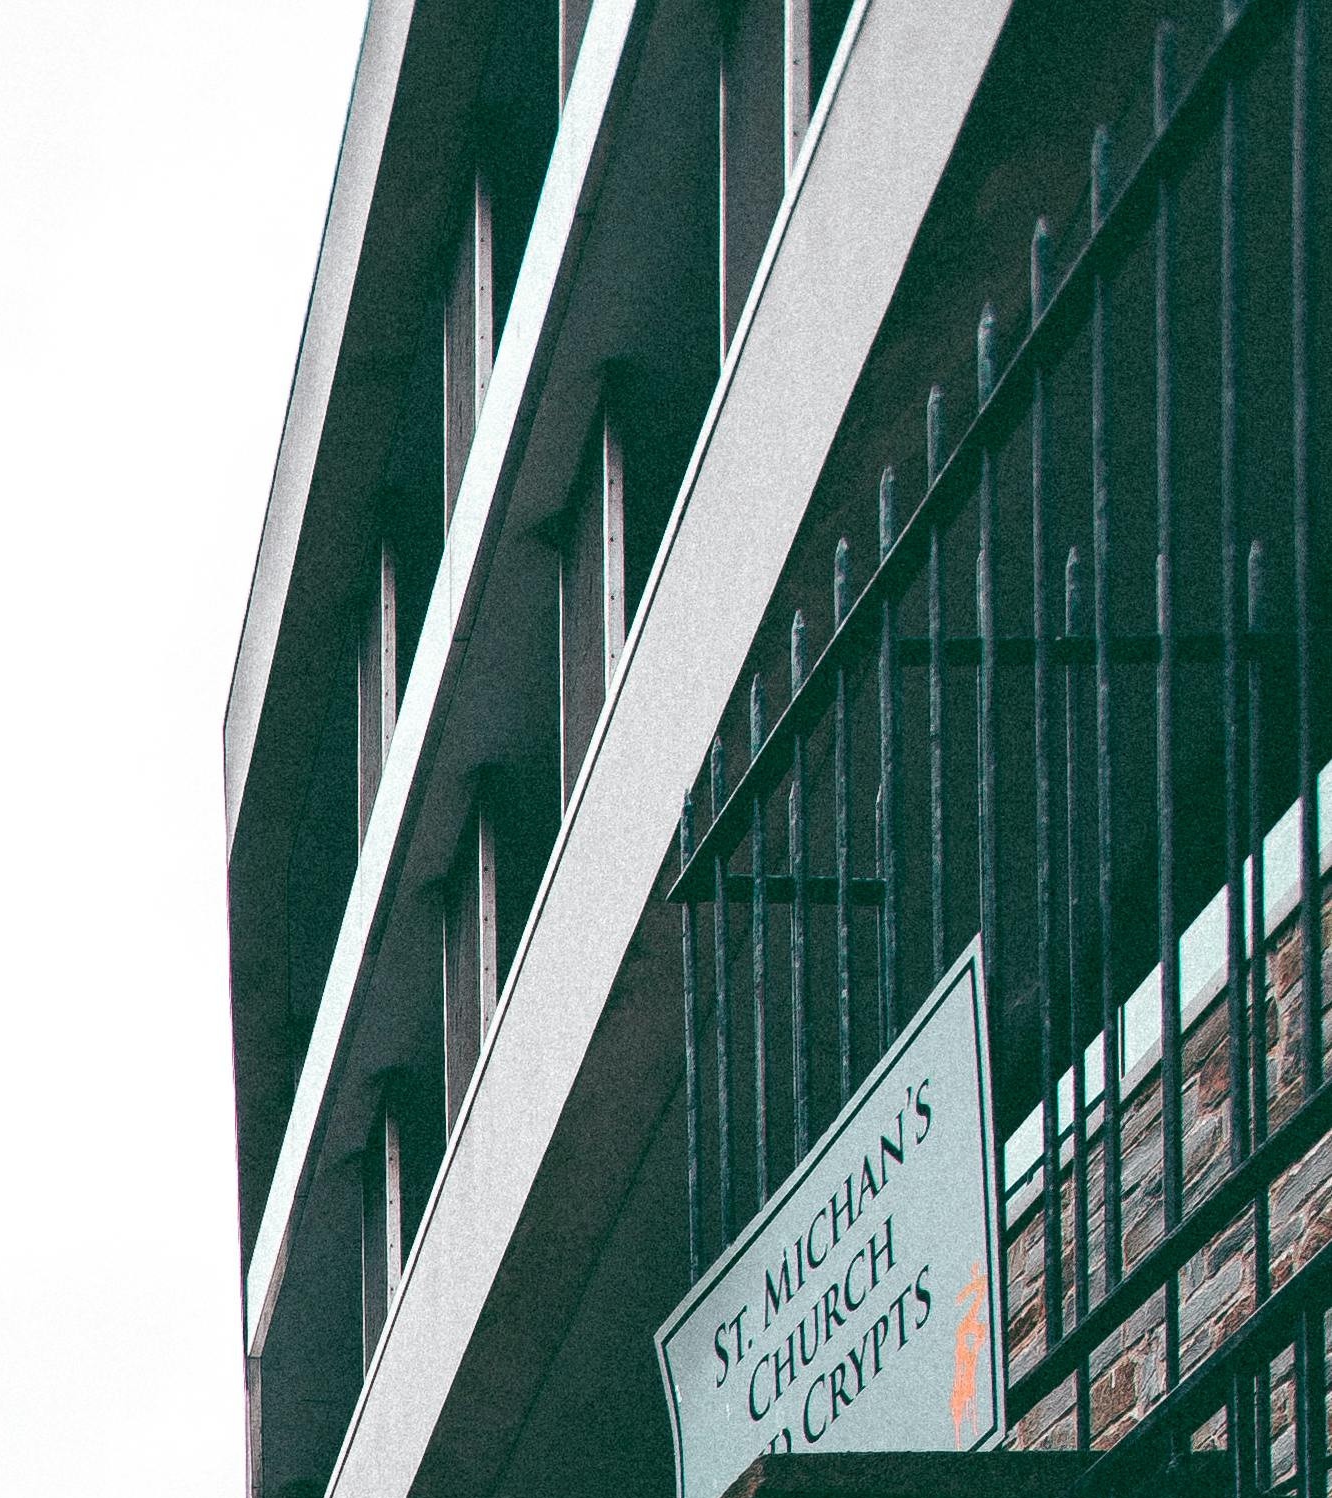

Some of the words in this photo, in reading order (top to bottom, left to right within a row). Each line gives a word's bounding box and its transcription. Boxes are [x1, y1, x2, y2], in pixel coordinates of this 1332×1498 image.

[713, 1306, 754, 1387] ST.
[763, 1077, 932, 1331] MICHAN'S
[748, 1215, 896, 1422] CHURCH
[803, 1264, 932, 1444] CRYPTS
